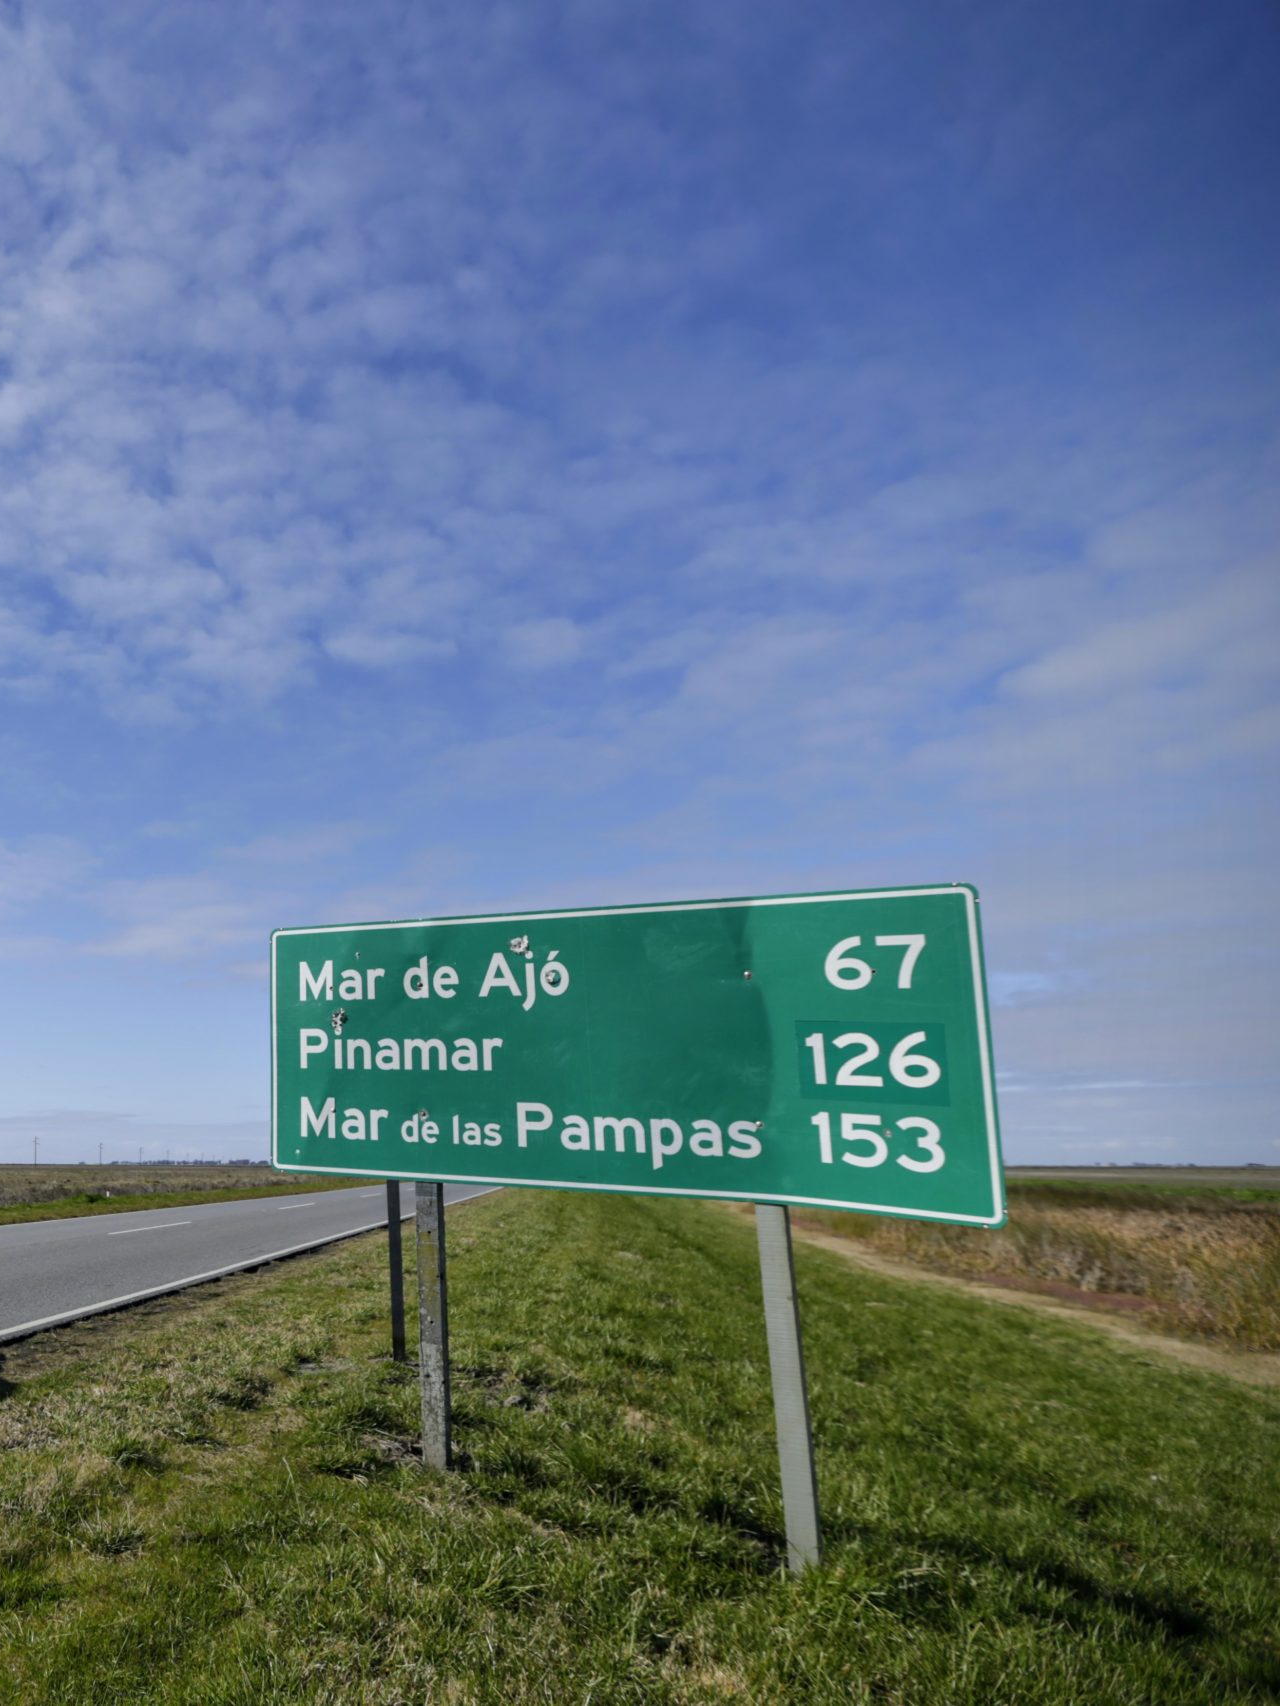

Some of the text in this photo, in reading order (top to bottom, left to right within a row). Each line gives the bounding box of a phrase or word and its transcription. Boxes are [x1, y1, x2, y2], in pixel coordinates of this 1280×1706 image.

[299, 933, 927, 1012] Mar de Ajó 67
[299, 1026, 942, 1089] Pinamar 126
[300, 1095, 947, 1174] Mar de las Pampas 153
